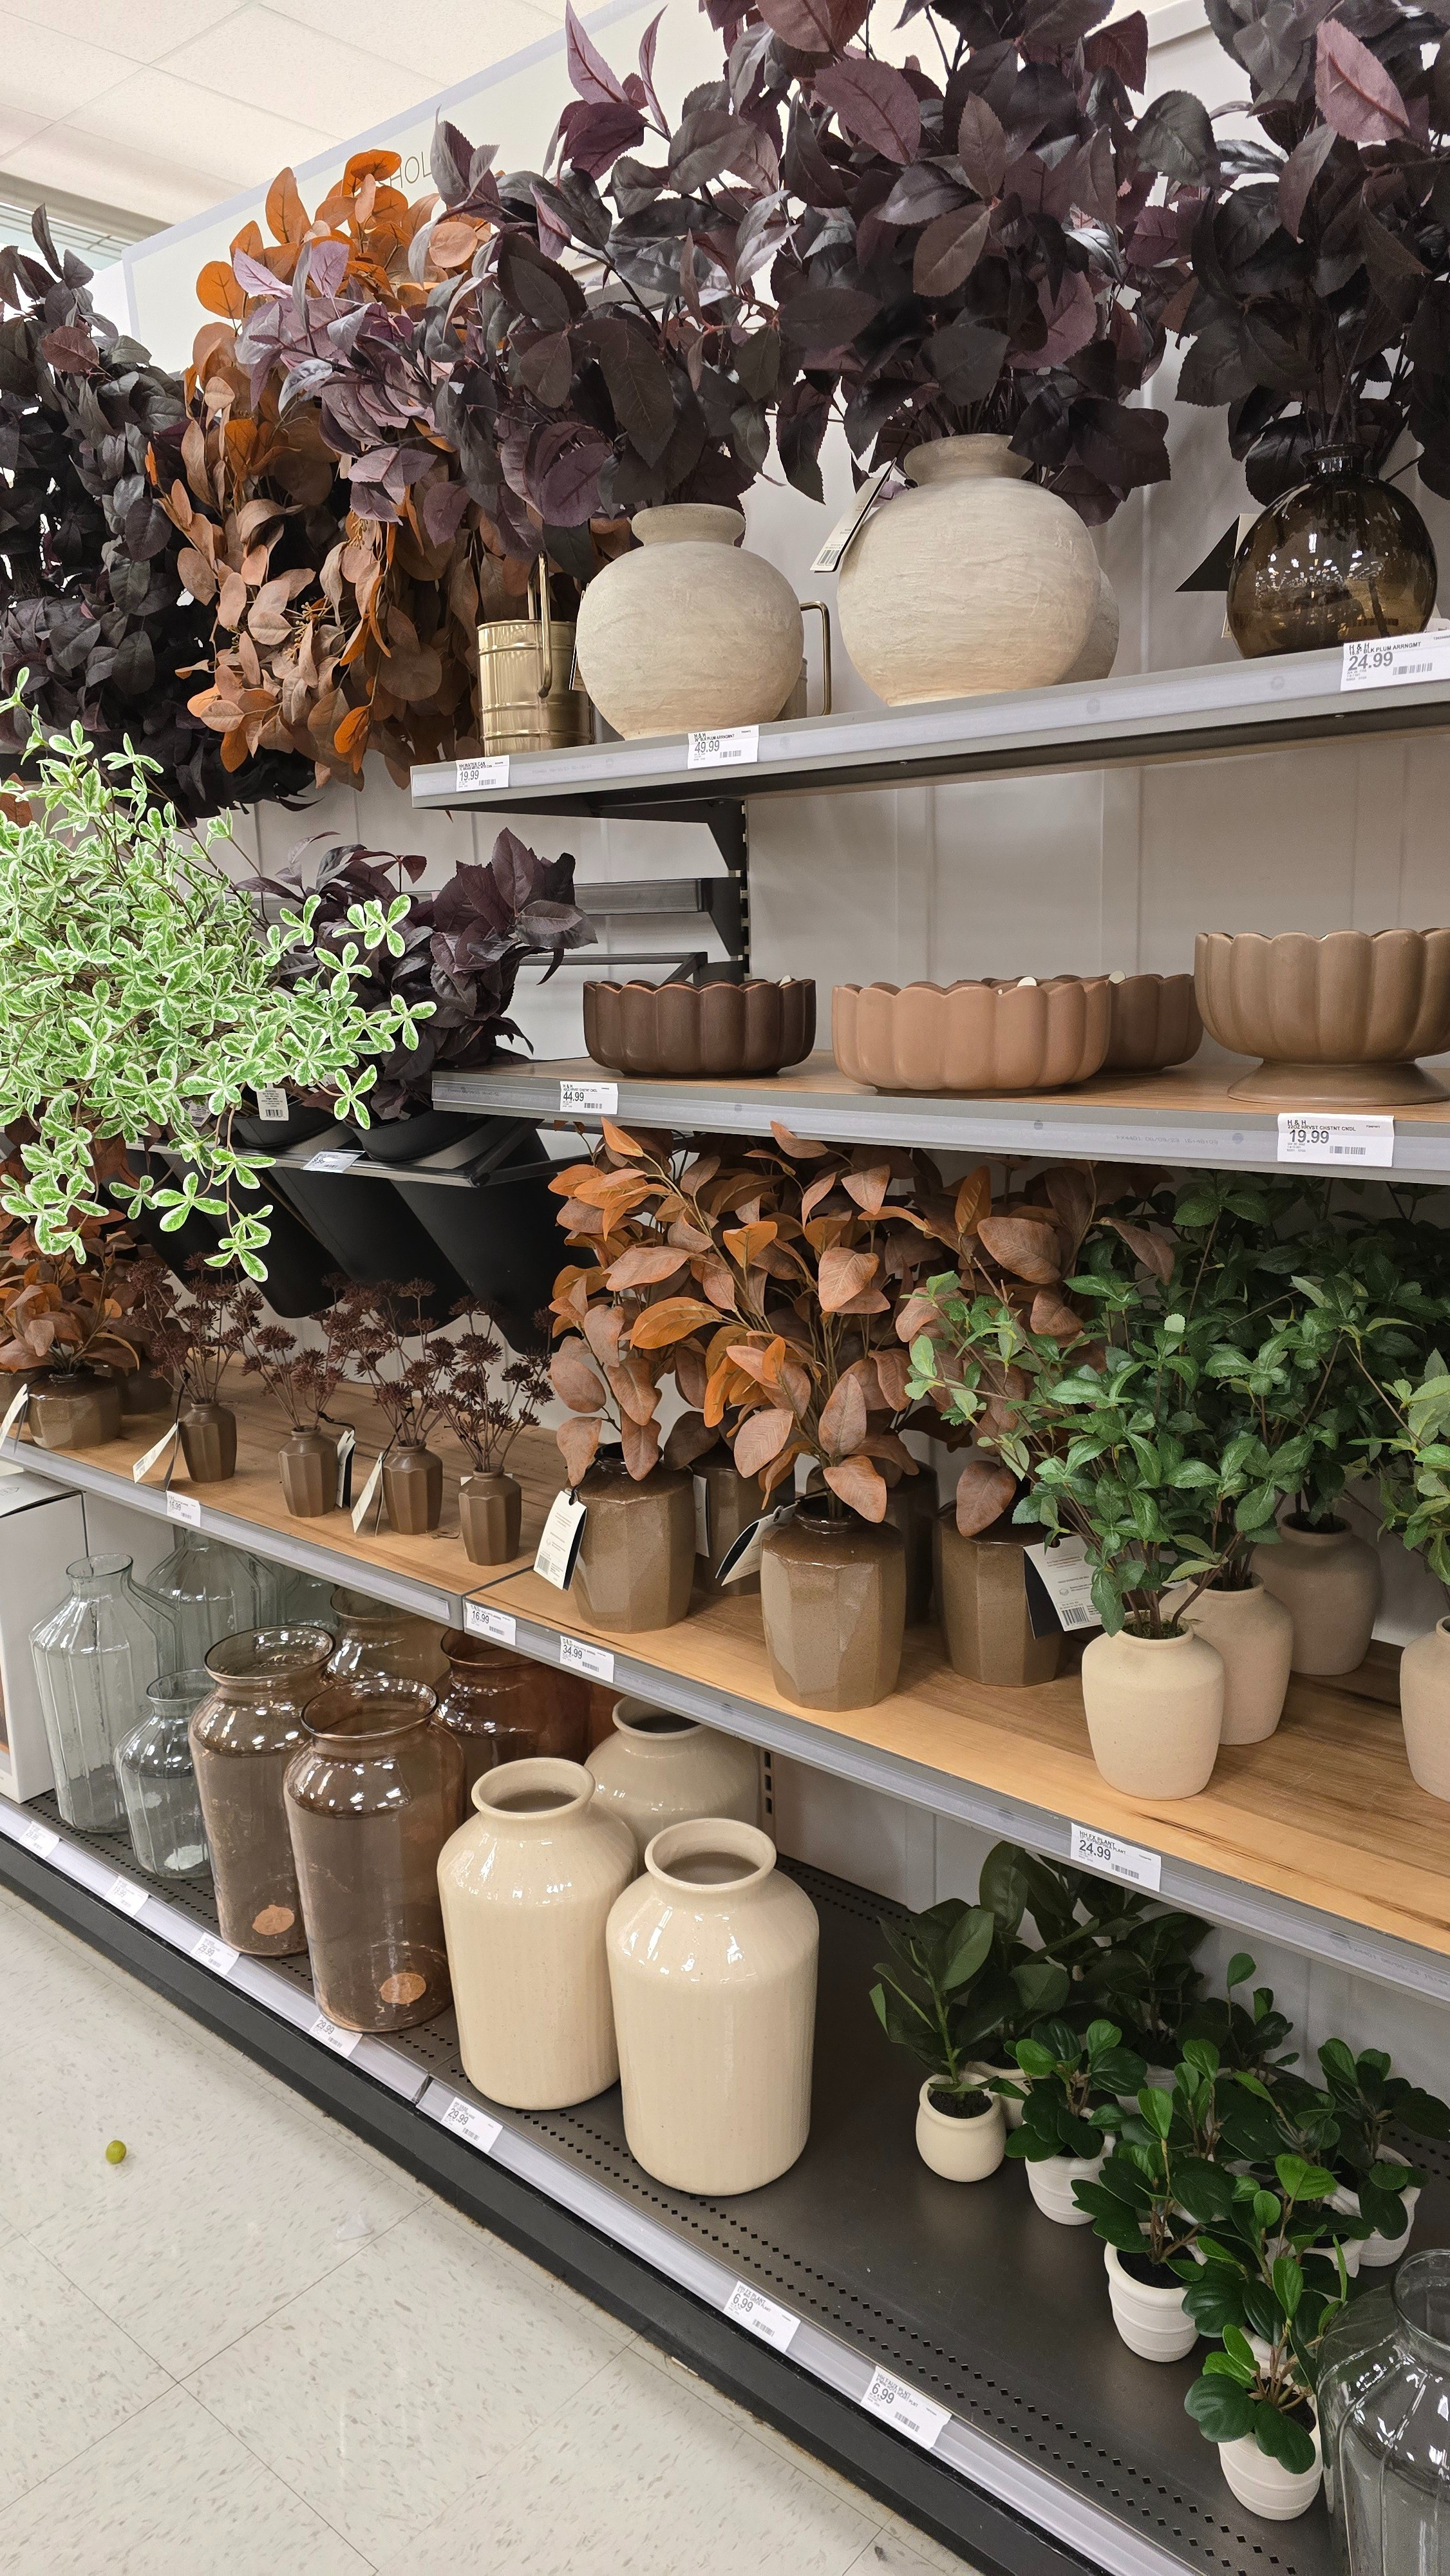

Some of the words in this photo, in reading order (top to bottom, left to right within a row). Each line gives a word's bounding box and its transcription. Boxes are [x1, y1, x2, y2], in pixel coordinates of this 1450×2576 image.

[378, 151, 432, 189] HOL
[1392, 641, 1422, 650] ARRNGMT
[1348, 651, 1393, 671] 24.99
[694, 740, 720, 753] 49.99
[460, 770, 479, 781] 19.99
[563, 1091, 585, 1102] 44.99
[1289, 1129, 1330, 1144] 19.99
[472, 1610, 489, 1624] 16.99
[563, 1644, 583, 1660] 34.99
[1097, 1837, 1115, 1846] PLANT
[1079, 1839, 1111, 1861] 24.99
[198, 1943, 215, 1957] 29.99
[316, 2019, 335, 2035] 29.99
[447, 2108, 469, 2126] 29.99
[733, 2293, 753, 2313] 6.99
[872, 2382, 895, 2404] 6.99
